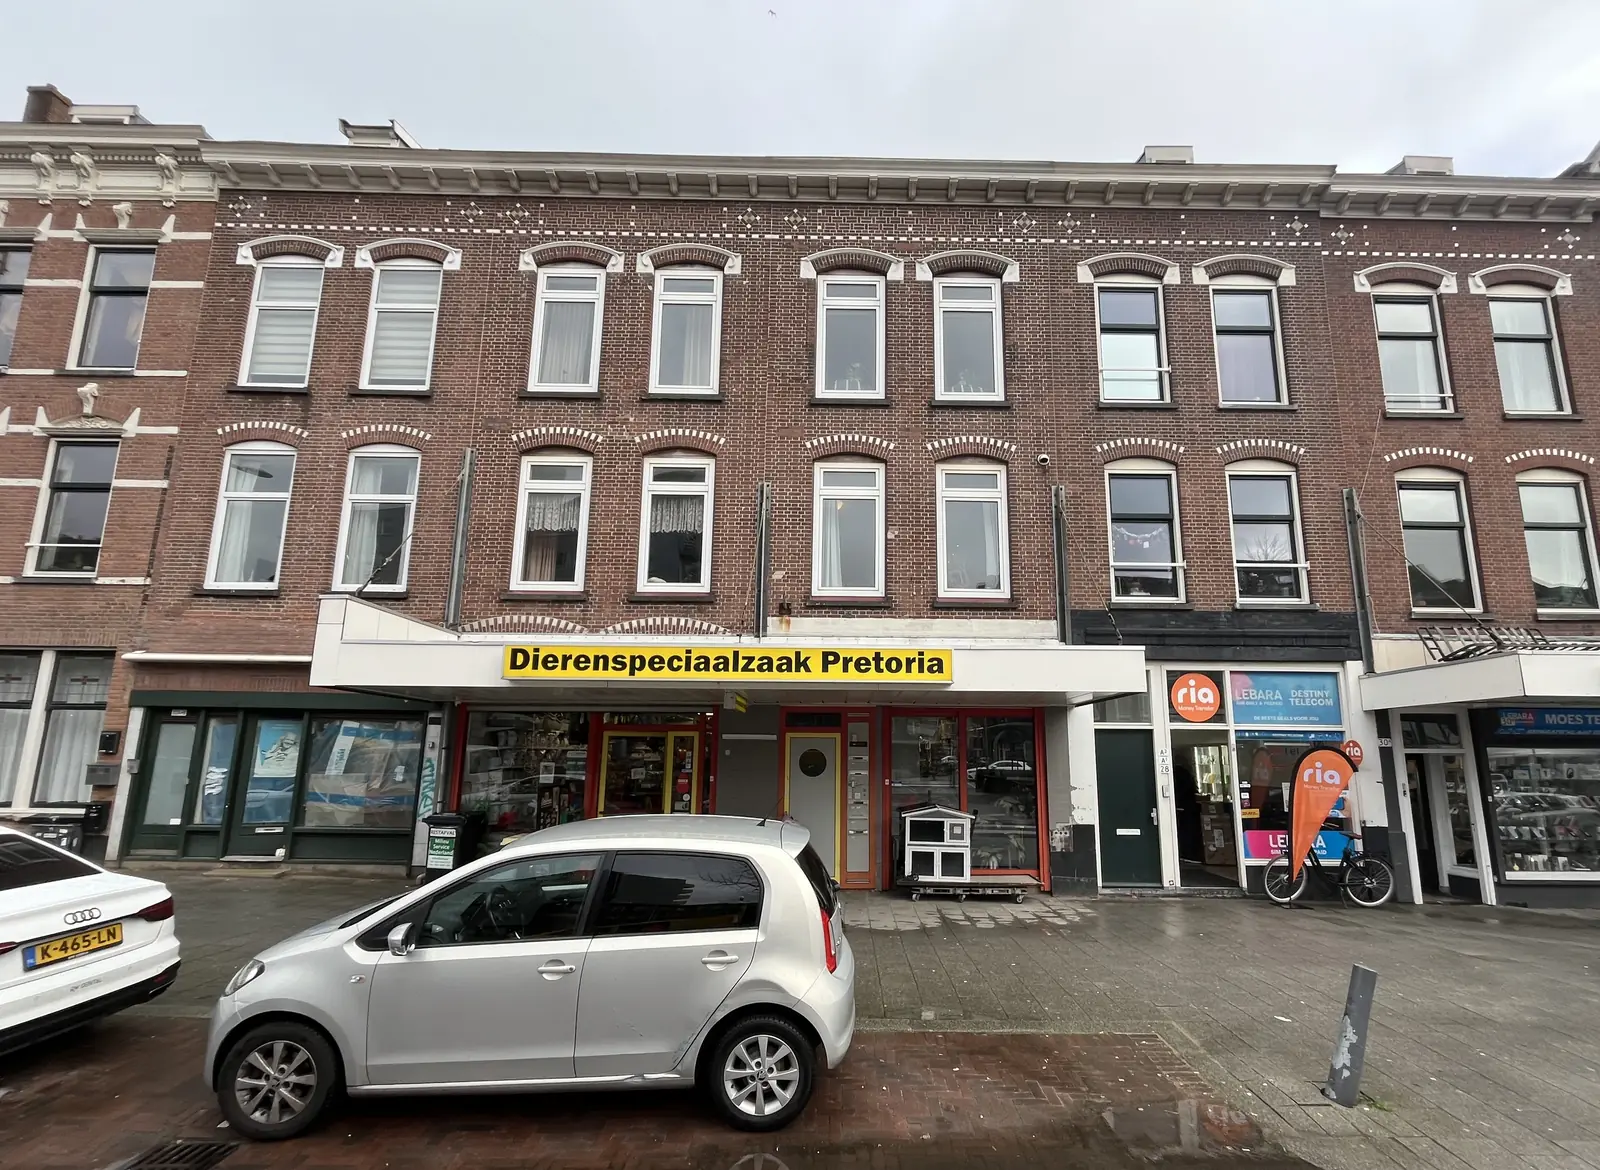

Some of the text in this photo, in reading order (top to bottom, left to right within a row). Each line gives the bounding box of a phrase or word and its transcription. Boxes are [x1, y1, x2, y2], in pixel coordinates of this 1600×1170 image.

[509, 648, 944, 676] Dierenspeciaalzaak Pretoria
[1177, 679, 1214, 704] ria
[1236, 689, 1283, 700] LEBARA
[1291, 690, 1330, 698] DESTINY
[1289, 698, 1334, 706] TELECOM
[1545, 714, 1584, 725] MOES
[1345, 742, 1361, 757] ria
[1160, 765, 1170, 773] 28
[1303, 761, 1341, 785] ria
[1269, 835, 1326, 848] LEA
[40, 927, 117, 960] K-465-LN
